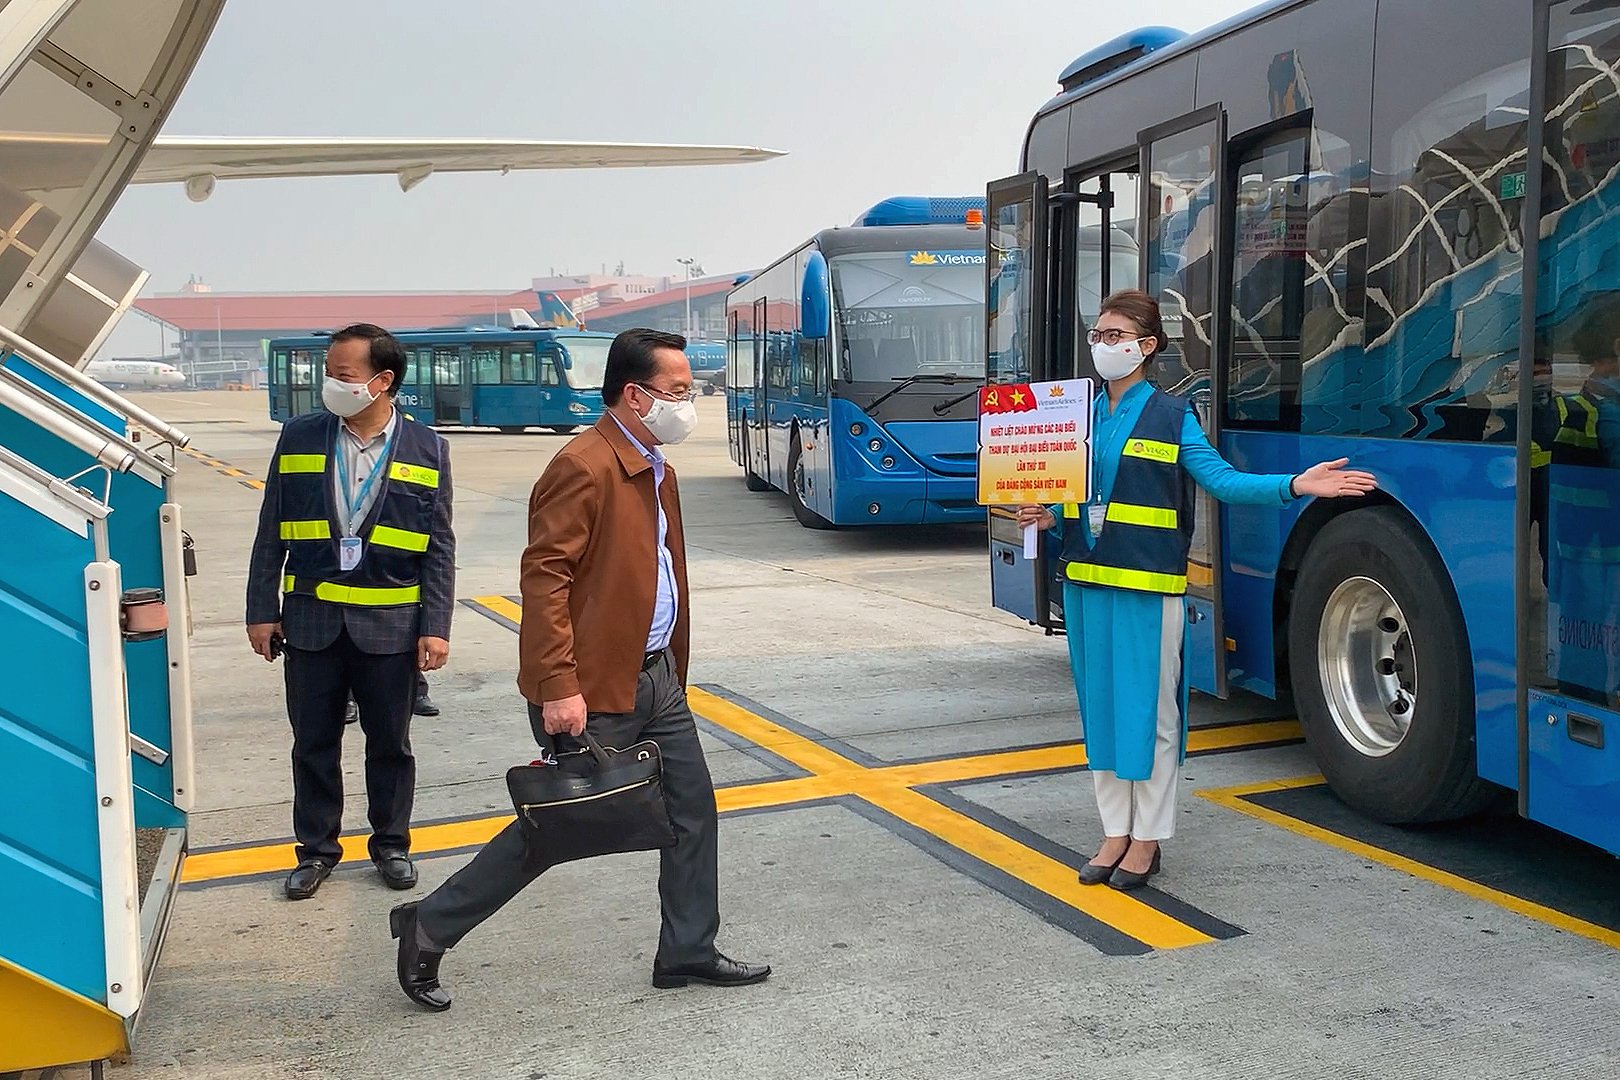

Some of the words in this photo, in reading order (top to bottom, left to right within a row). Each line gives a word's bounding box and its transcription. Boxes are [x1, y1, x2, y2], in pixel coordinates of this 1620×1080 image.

[1015, 424, 1027, 435] CHÀO
[1028, 423, 1043, 434] MỪNG
[1045, 422, 1054, 433] CÁC
[1055, 423, 1063, 435] ĐẠI
[1065, 420, 1076, 432] BIỂU
[989, 445, 1001, 455] THAM
[1063, 438, 1077, 451] QUỐC
[1016, 459, 1025, 471] LẦN
[1027, 460, 1037, 471] THỨ
[996, 478, 1005, 490] CỦA
[1006, 478, 1019, 490] ĐẢNG
[1020, 478, 1032, 491] CỘNG
[1034, 477, 1043, 489] SẢN
[1044, 477, 1054, 489] VIỆT
[1056, 479, 1067, 489] NAM
